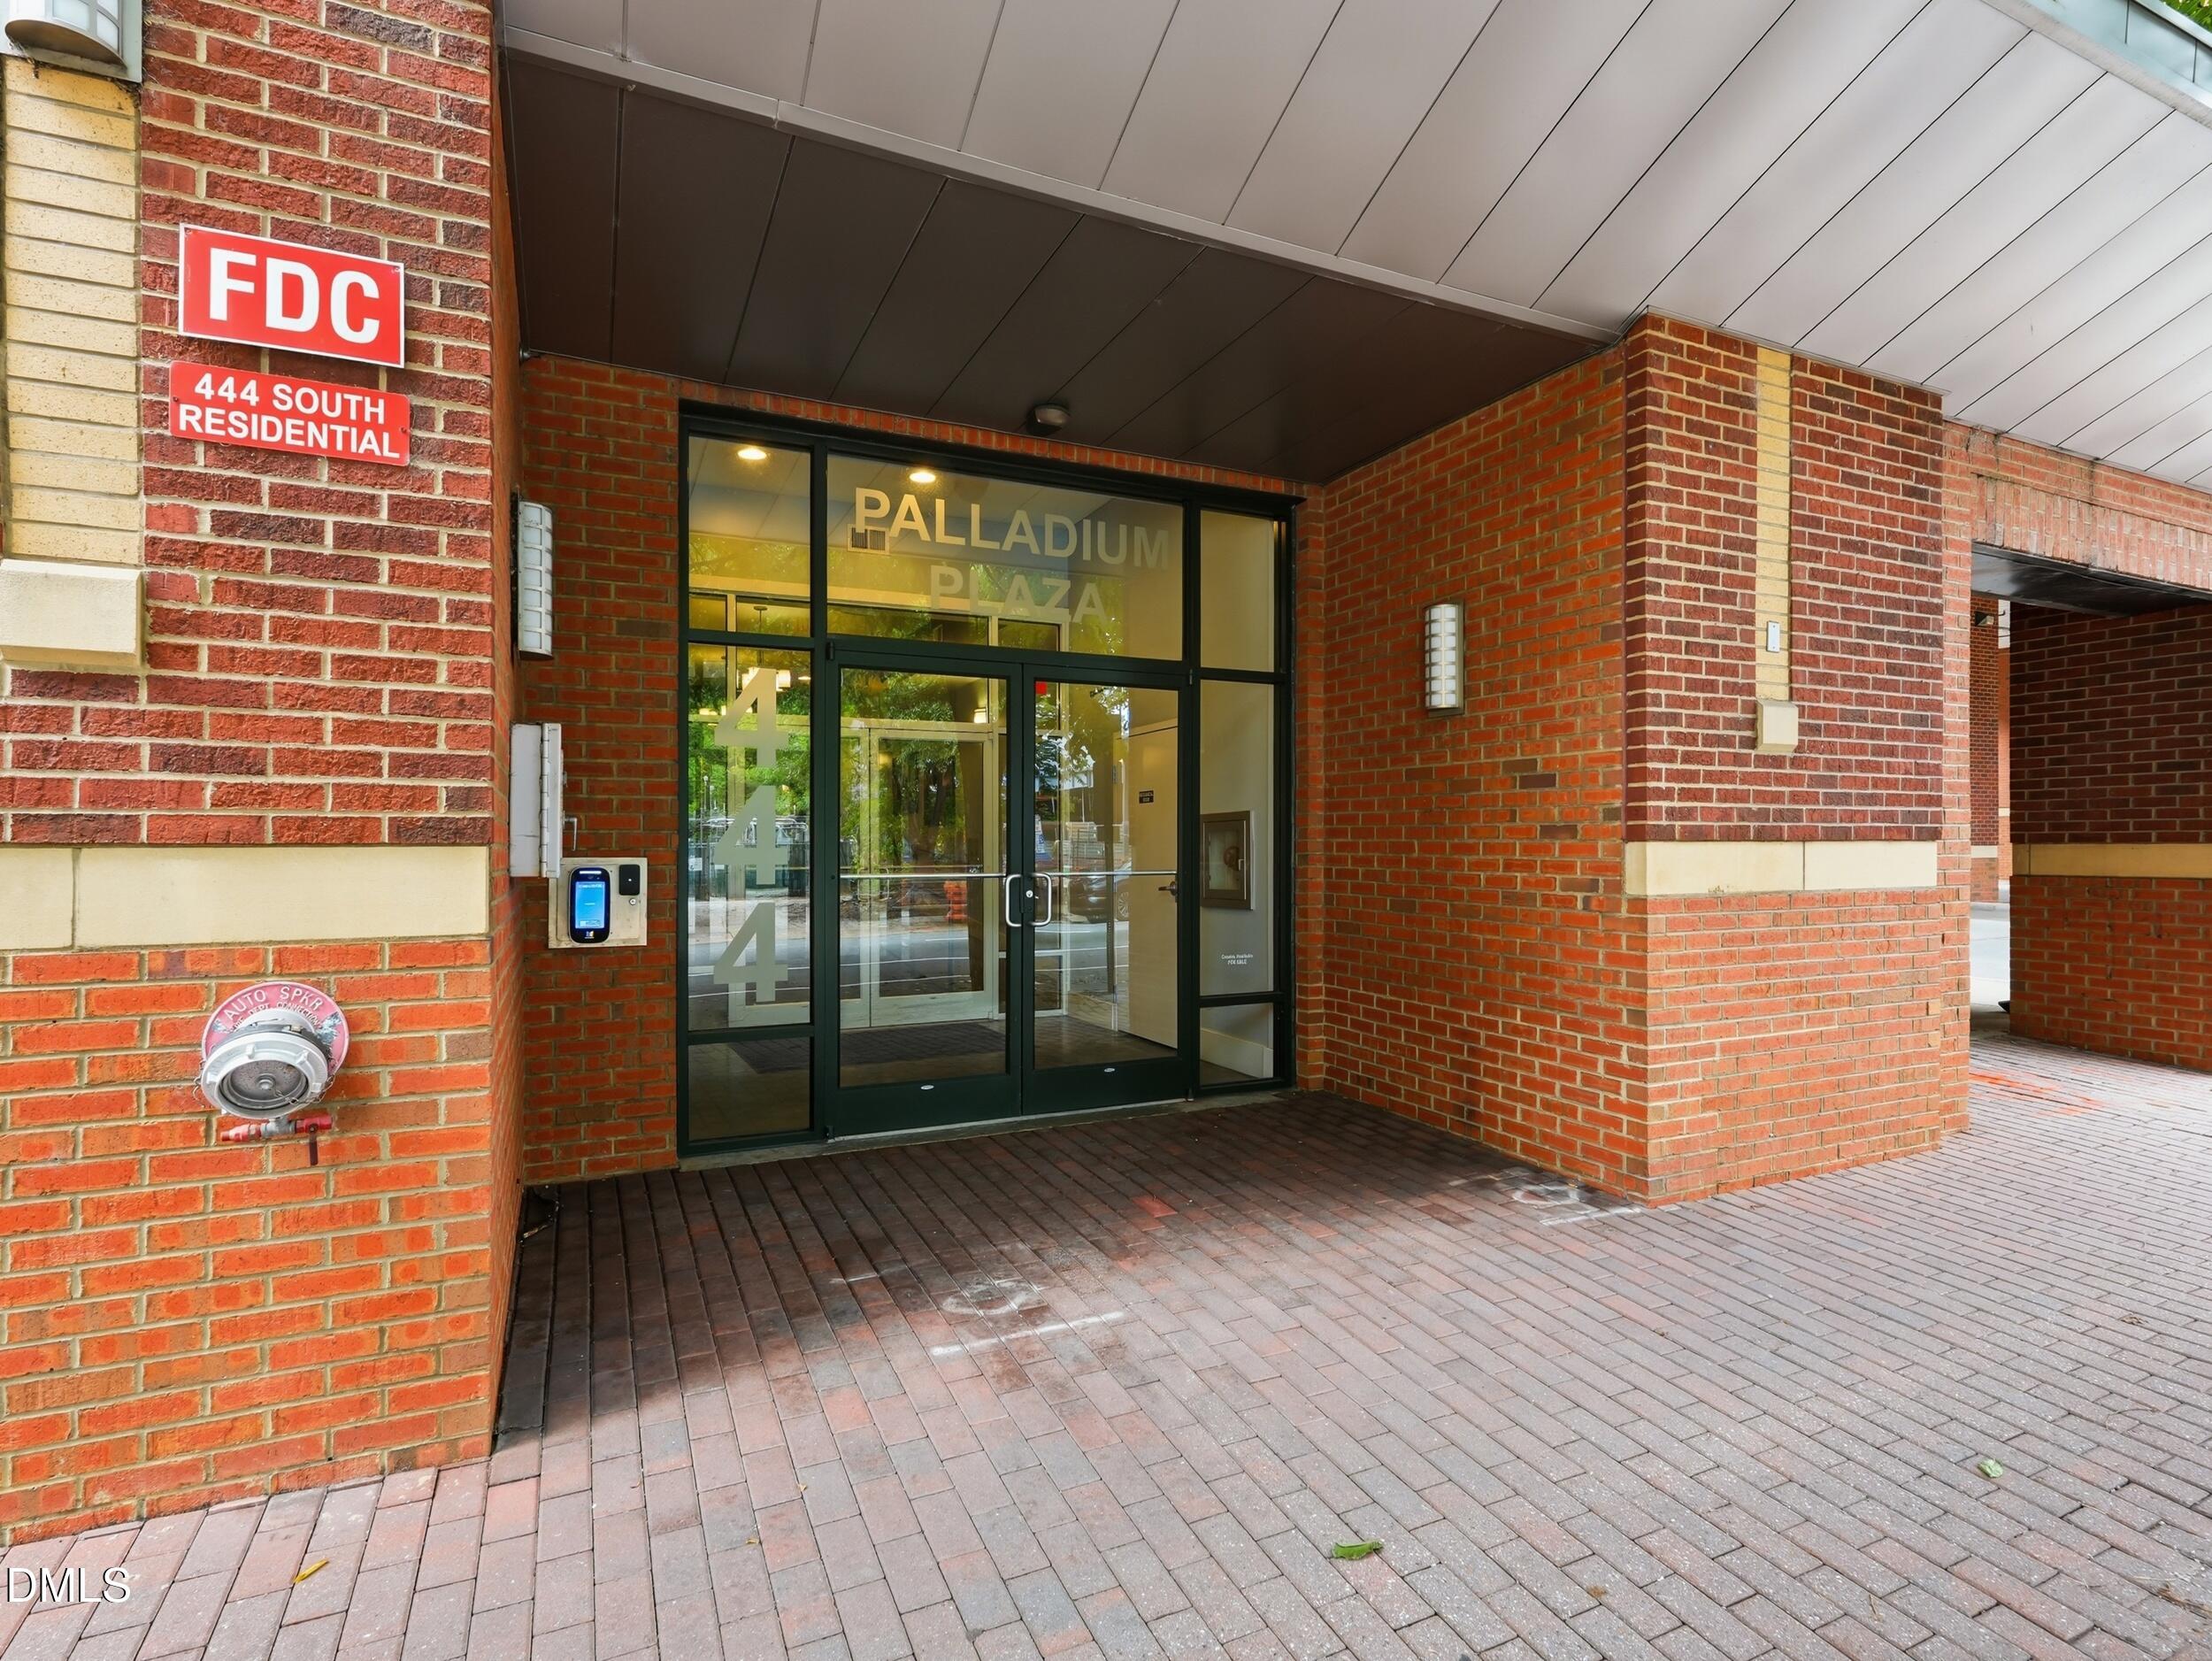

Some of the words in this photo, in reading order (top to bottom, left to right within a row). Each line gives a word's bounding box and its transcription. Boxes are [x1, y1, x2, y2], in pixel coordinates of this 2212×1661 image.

[209, 247, 380, 344] FDC
[194, 373, 260, 406] 444
[272, 383, 385, 425] SOUTH
[179, 404, 400, 458] RESIDENTIAL
[855, 487, 1169, 571] PALLADIUM
[929, 564, 1108, 625] PLAZA
[713, 667, 789, 1003] 444
[223, 989, 267, 1020] AUTO
[279, 986, 324, 1011] SPKR
